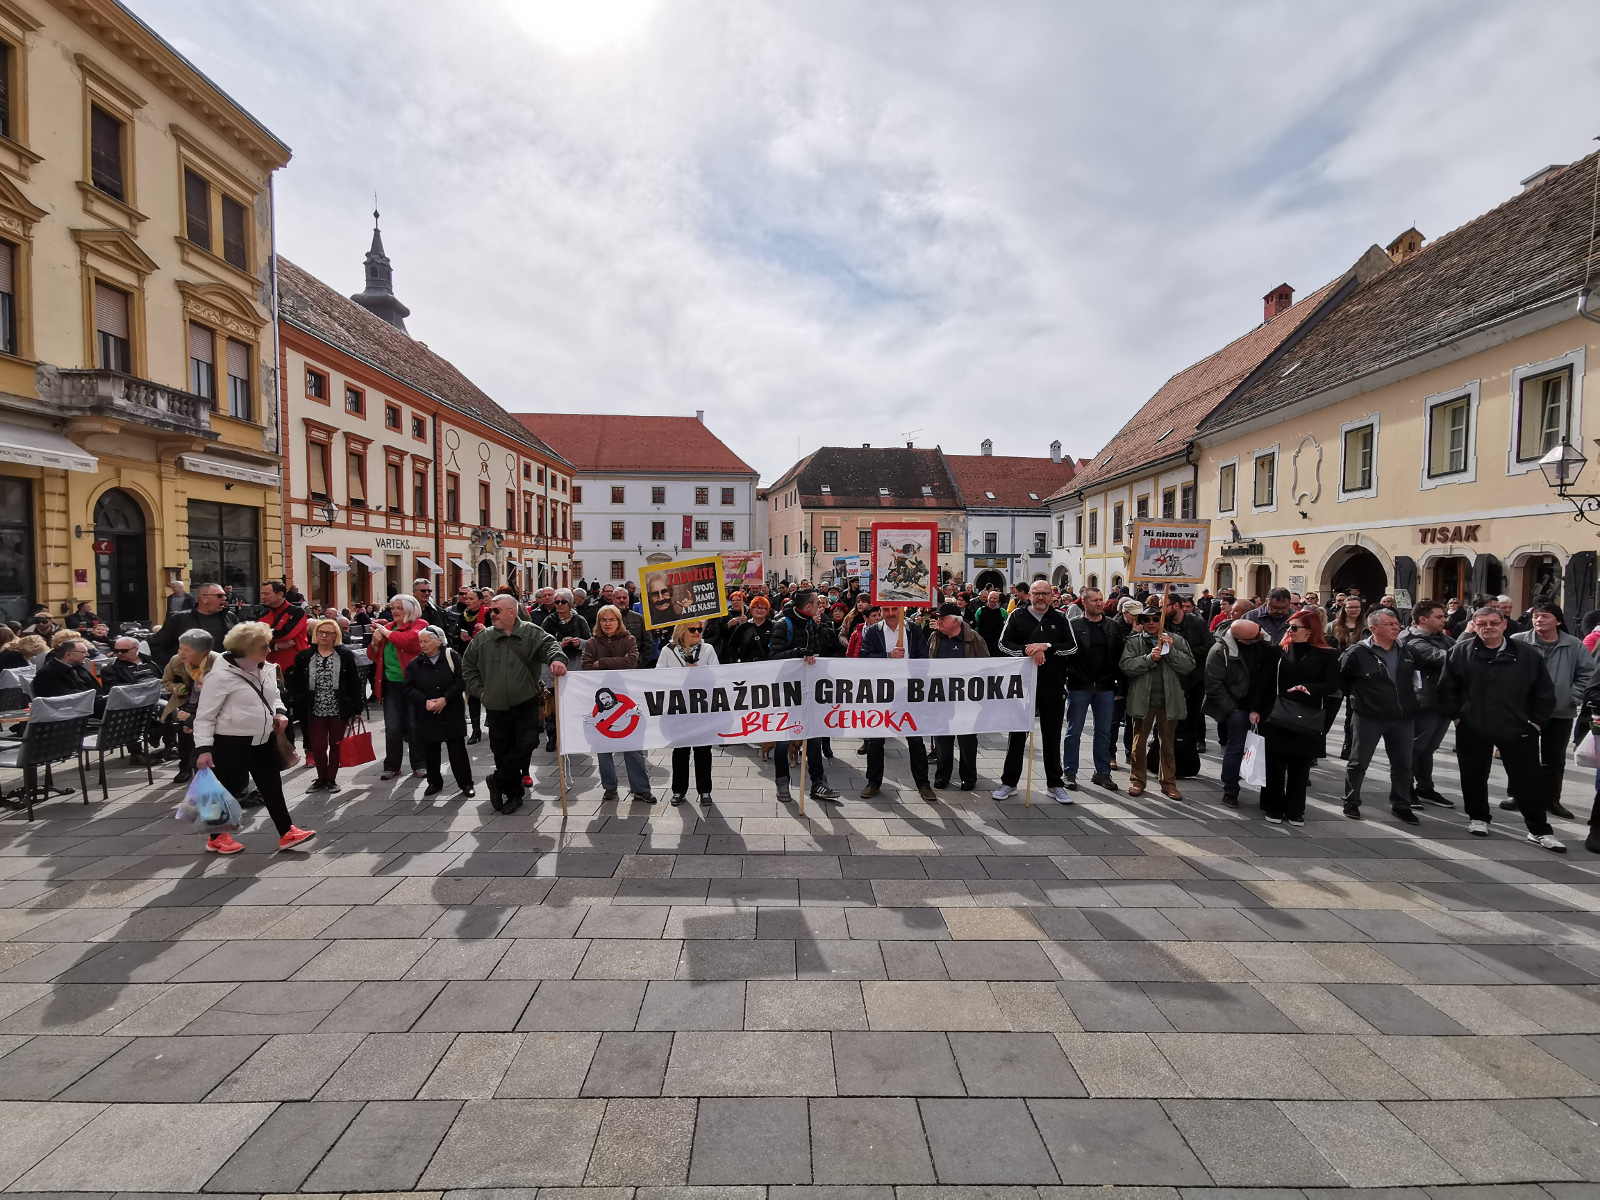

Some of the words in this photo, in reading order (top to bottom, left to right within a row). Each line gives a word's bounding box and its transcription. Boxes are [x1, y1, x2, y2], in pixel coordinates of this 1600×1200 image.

[1156, 530, 1182, 538] nismo
[1419, 525, 1481, 545] TISAK
[375, 538, 410, 549] VARTEKS
[1150, 538, 1196, 549] BANKOMAT
[667, 567, 714, 586] ZADUŽITE
[693, 582, 714, 593] SVOJU
[695, 592, 715, 602] MAMU
[681, 606, 687, 614] A
[687, 604, 697, 613] NE
[644, 680, 802, 716] VARAŽDIN
[814, 678, 895, 704] GRAD
[907, 674, 1024, 702] BAROKA
[717, 711, 803, 737] BEZ
